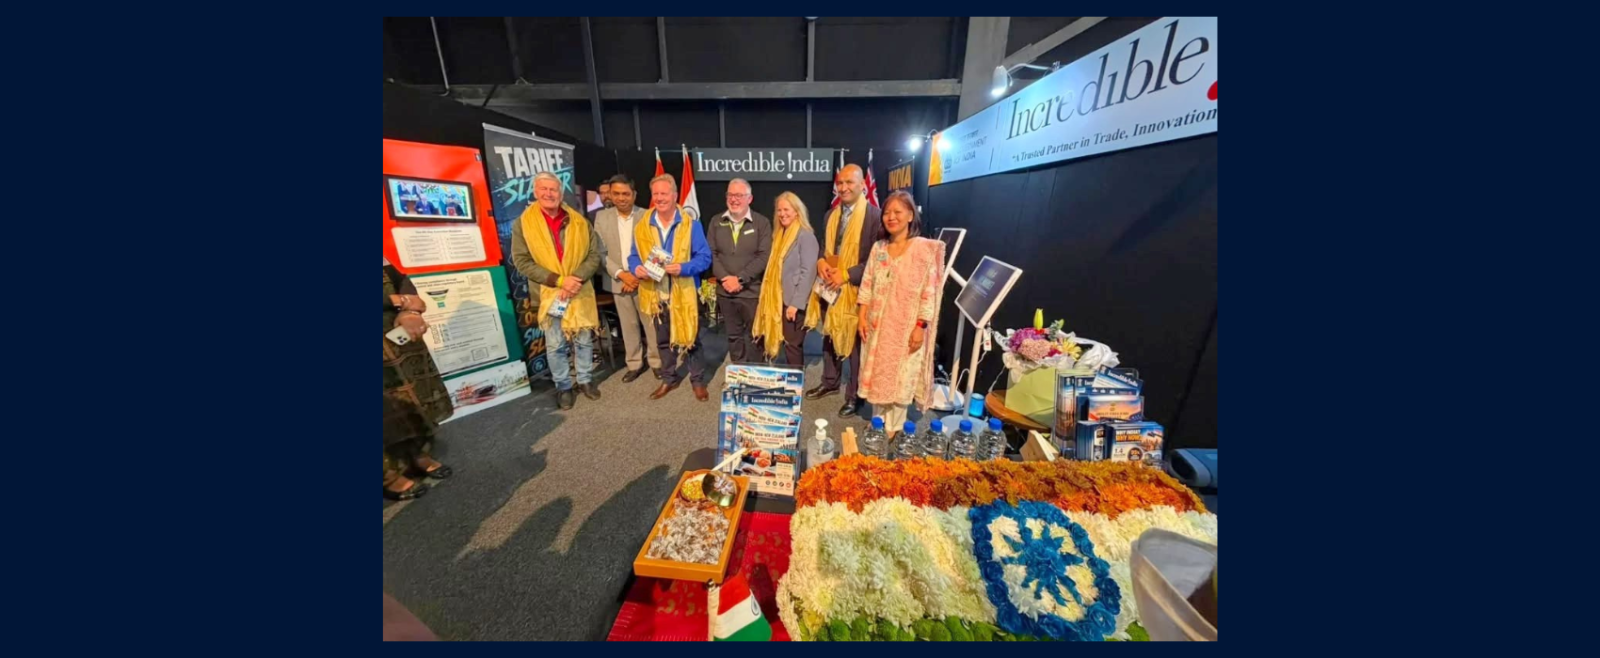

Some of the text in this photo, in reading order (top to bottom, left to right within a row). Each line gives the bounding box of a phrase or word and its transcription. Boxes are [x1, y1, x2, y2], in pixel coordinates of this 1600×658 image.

[1006, 19, 1209, 140] Incredible
[1021, 146, 1045, 160] Trusted
[1046, 139, 1077, 155] Partner
[1080, 136, 1090, 148] in
[1093, 128, 1128, 146] Trade,
[1133, 107, 1217, 136] Innovation
[494, 146, 563, 178] TARIFF
[697, 151, 785, 172] Incredible
